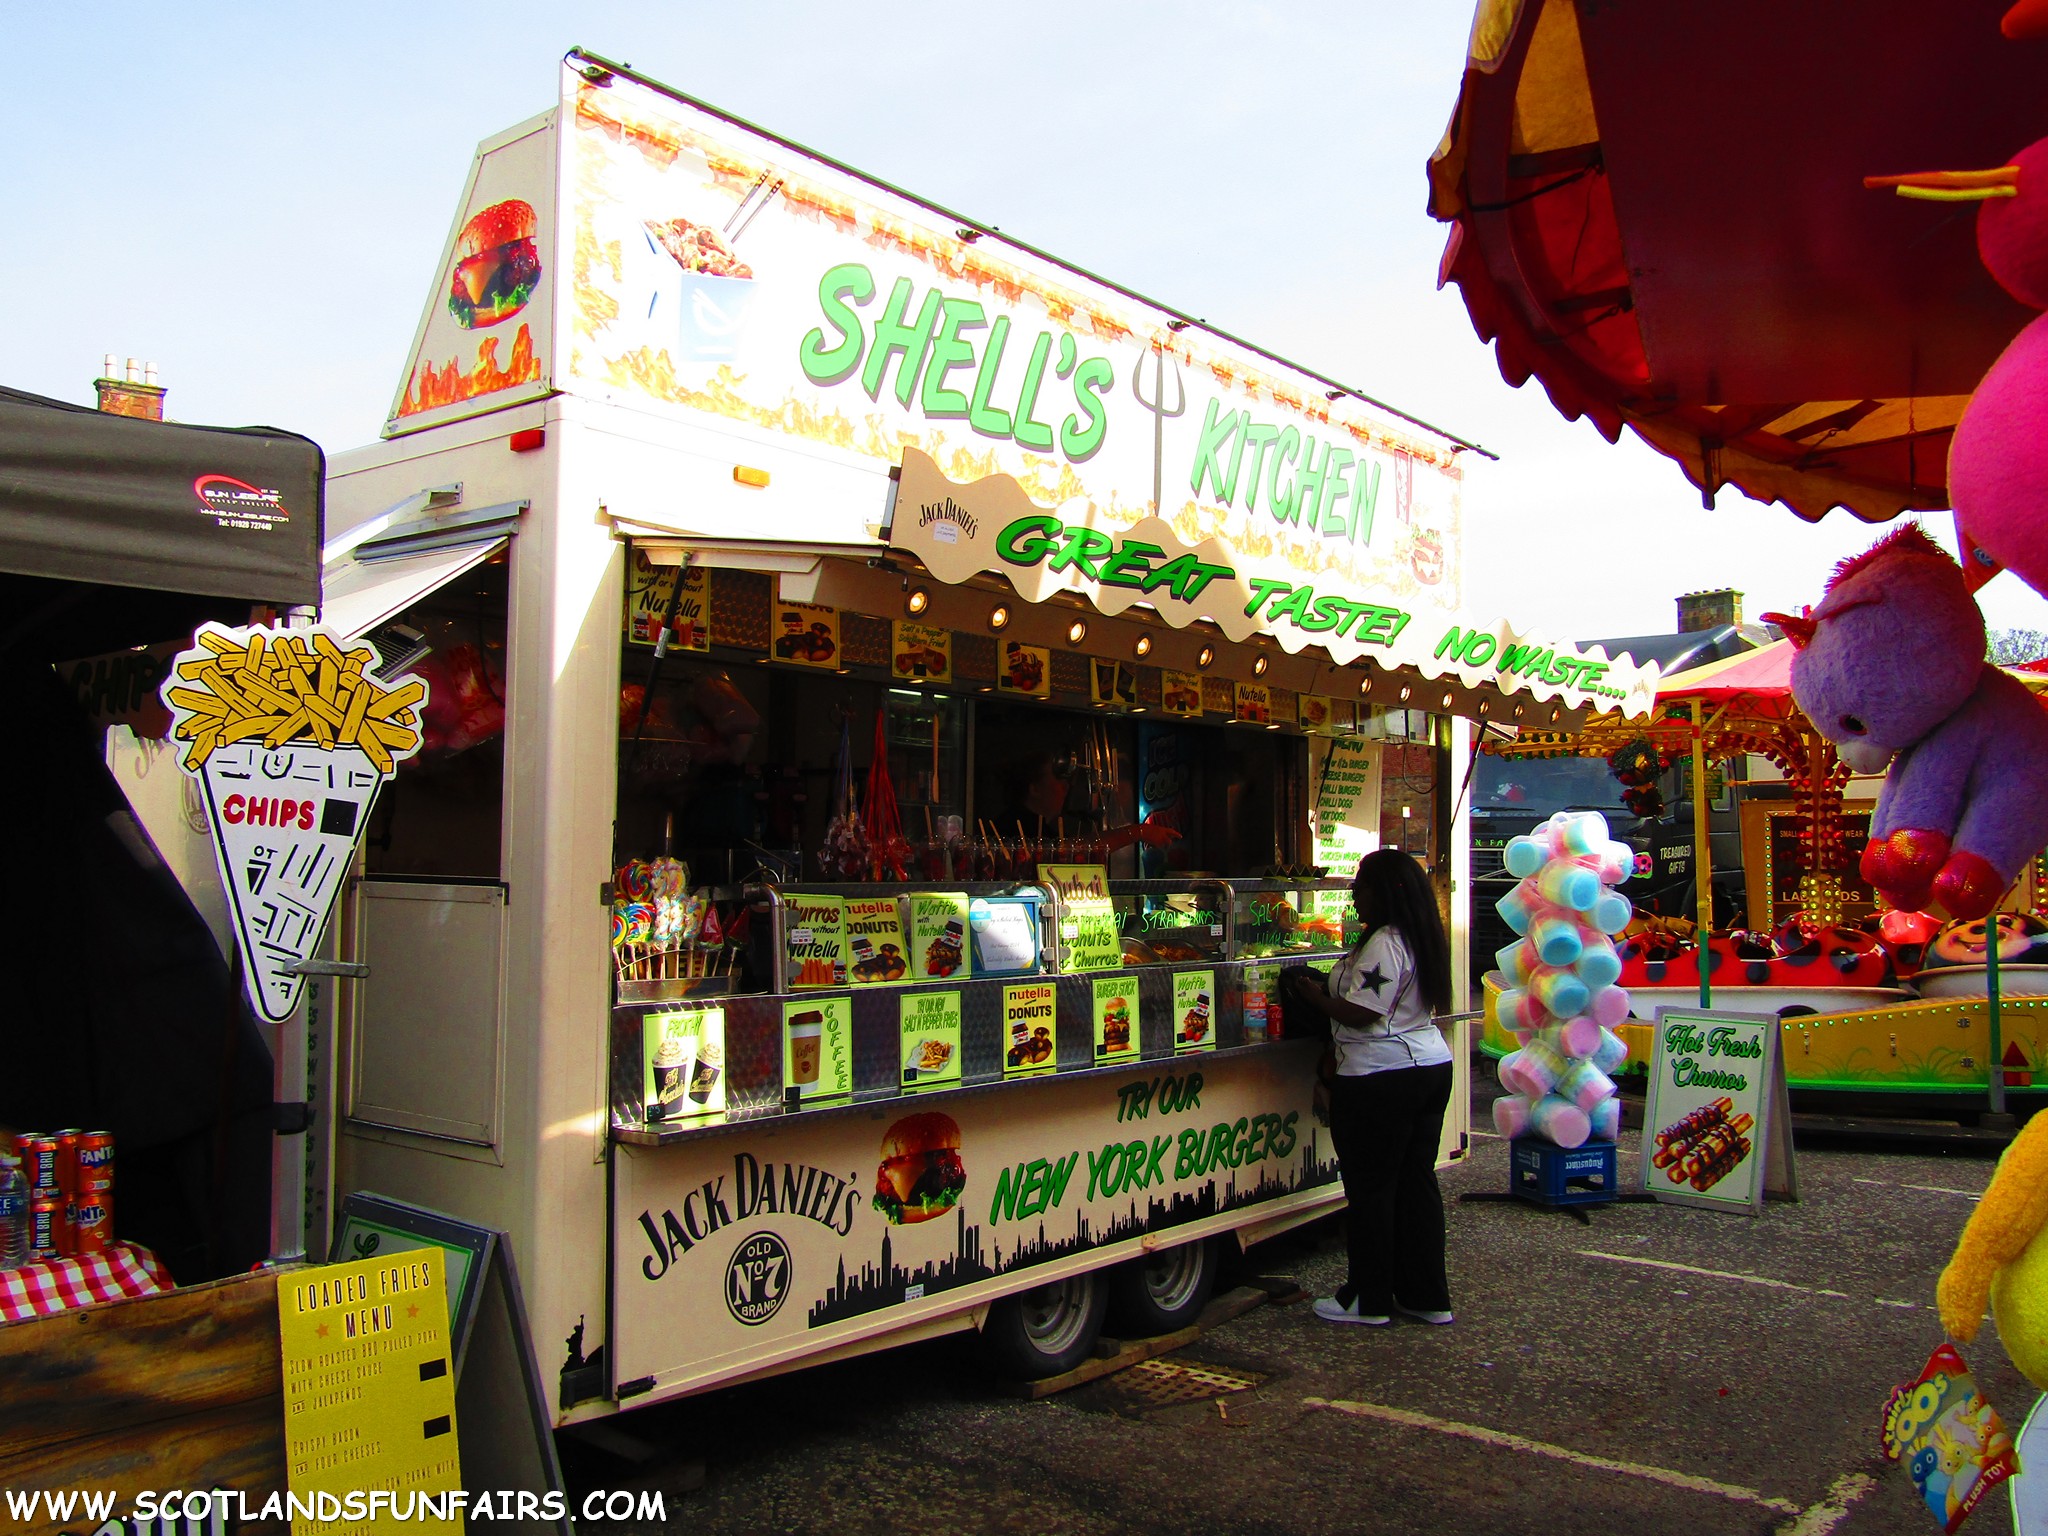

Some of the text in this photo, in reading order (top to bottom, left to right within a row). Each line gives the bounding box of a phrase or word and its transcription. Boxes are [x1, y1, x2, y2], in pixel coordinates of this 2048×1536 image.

[800, 263, 1117, 463] SHELL'S
[1190, 397, 1381, 547] KITCHEN
[204, 490, 229, 498] SUN
[919, 497, 979, 540] JACK DANIEL'S
[996, 514, 1235, 602] GREAT
[1245, 577, 1411, 648] TASTE!
[1434, 625, 1497, 669] NO
[72, 654, 171, 716] CHIP
[1238, 685, 1267, 703] Nutella
[223, 793, 316, 831] CHIPS
[1660, 844, 1691, 860] TREASURED
[1668, 860, 1686, 874] GIFTS
[916, 899, 959, 916] Waffle
[916, 916, 930, 925] with
[846, 920, 899, 935] DONUTS
[1073, 949, 1118, 968] Churros
[1009, 987, 1051, 1001] nutella
[1177, 976, 1207, 991] Waffle
[1008, 1005, 1053, 1021] DONUTS
[824, 1003, 847, 1090] COFFEE
[1665, 1024, 1762, 1059] Hot Fresh
[1671, 1057, 1748, 1091] Churros
[1117, 1072, 1204, 1123] TRY OUR
[988, 1110, 1300, 1226] NEW YORK BURGERS
[637, 1152, 862, 1281] JACK DANIEL'S
[746, 1240, 772, 1258] OLD
[296, 1261, 431, 1313] LOADED FRIES
[344, 1304, 393, 1339] MENU
[740, 1299, 778, 1319] BRAND
[319, 1347, 357, 1368] ROASTED
[383, 1334, 414, 1352] PULLED
[417, 1329, 438, 1345] PORK
[290, 1361, 382, 1395] WITH CHEESE SAUCE
[293, 1427, 361, 1456] CRISPY BACON
[315, 1453, 338, 1471] FOUR
[405, 1465, 432, 1485] CARNE
[1962, 1459, 2007, 1512] PLUSH TOY
